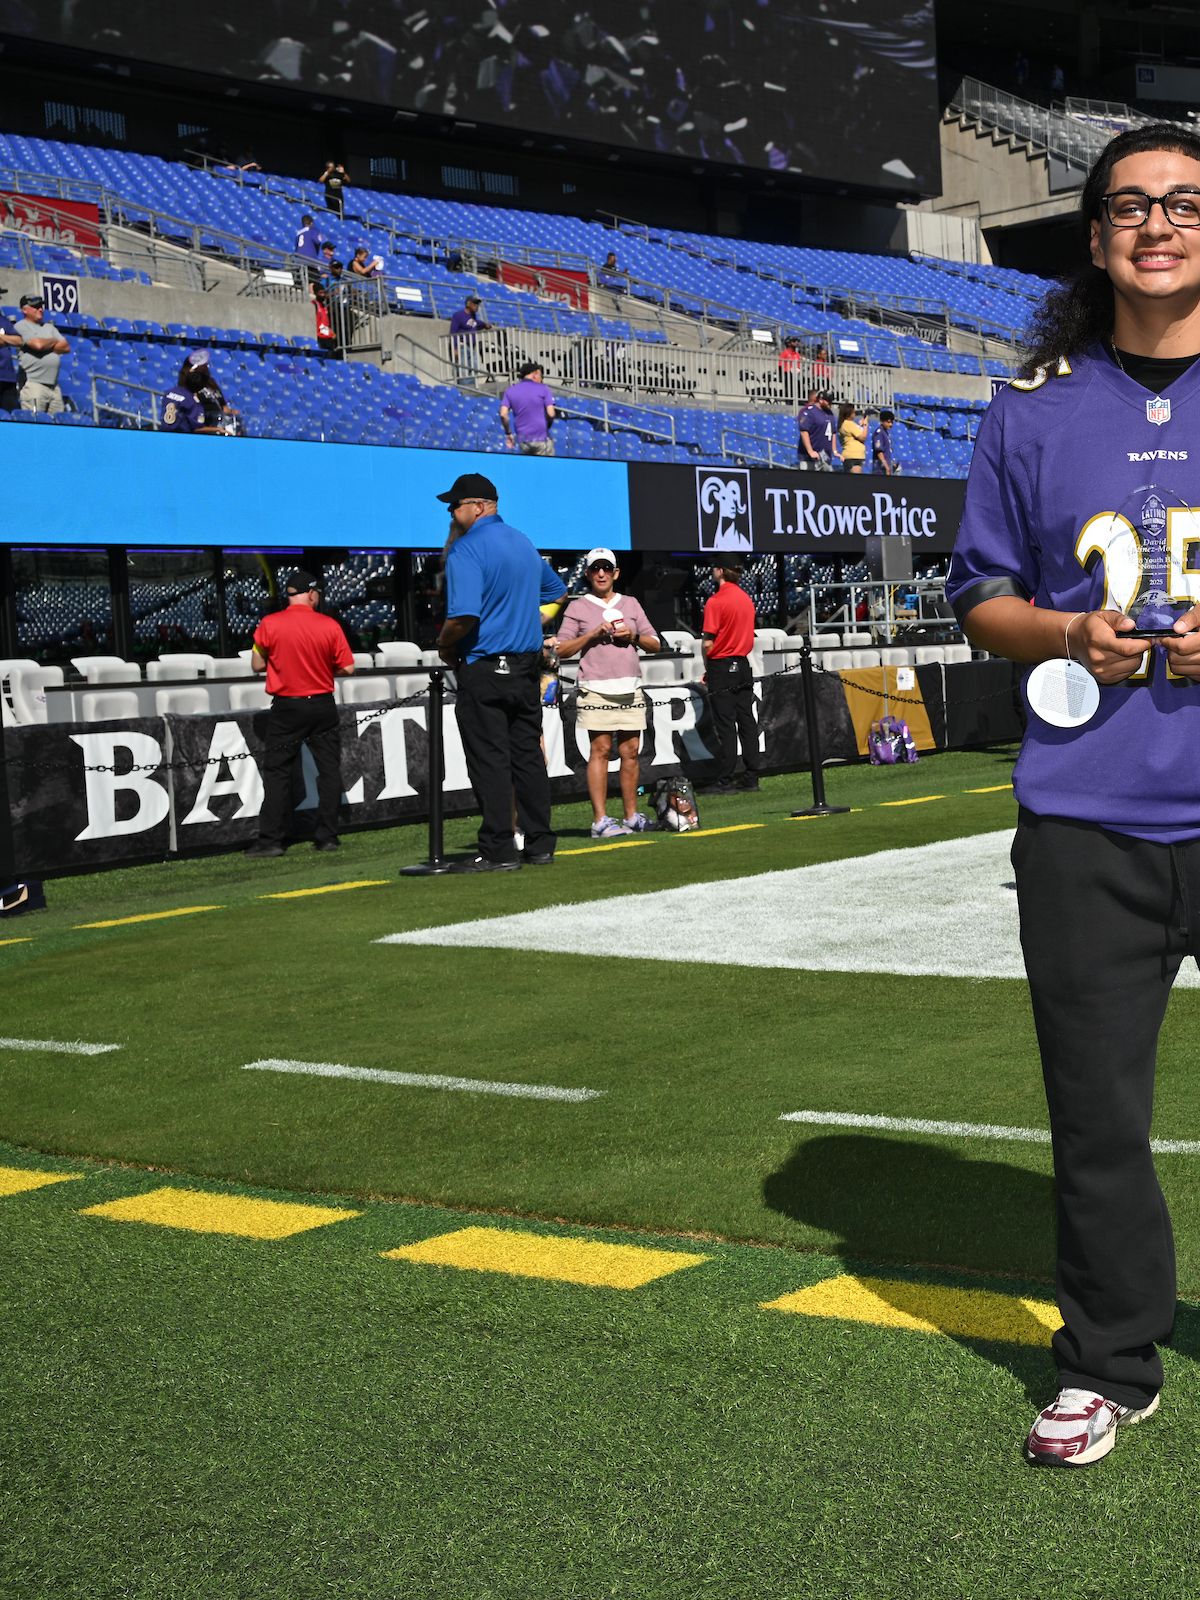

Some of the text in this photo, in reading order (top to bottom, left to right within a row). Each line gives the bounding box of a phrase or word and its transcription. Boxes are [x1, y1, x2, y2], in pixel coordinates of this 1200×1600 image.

[44, 282, 77, 314] 139
[163, 402, 177, 424] 8
[1150, 408, 1167, 420] NFL
[824, 422, 833, 441] 4
[1127, 450, 1188, 461] RAVENS
[1142, 508, 1166, 520] LATINO
[1143, 538, 1166, 546] David
